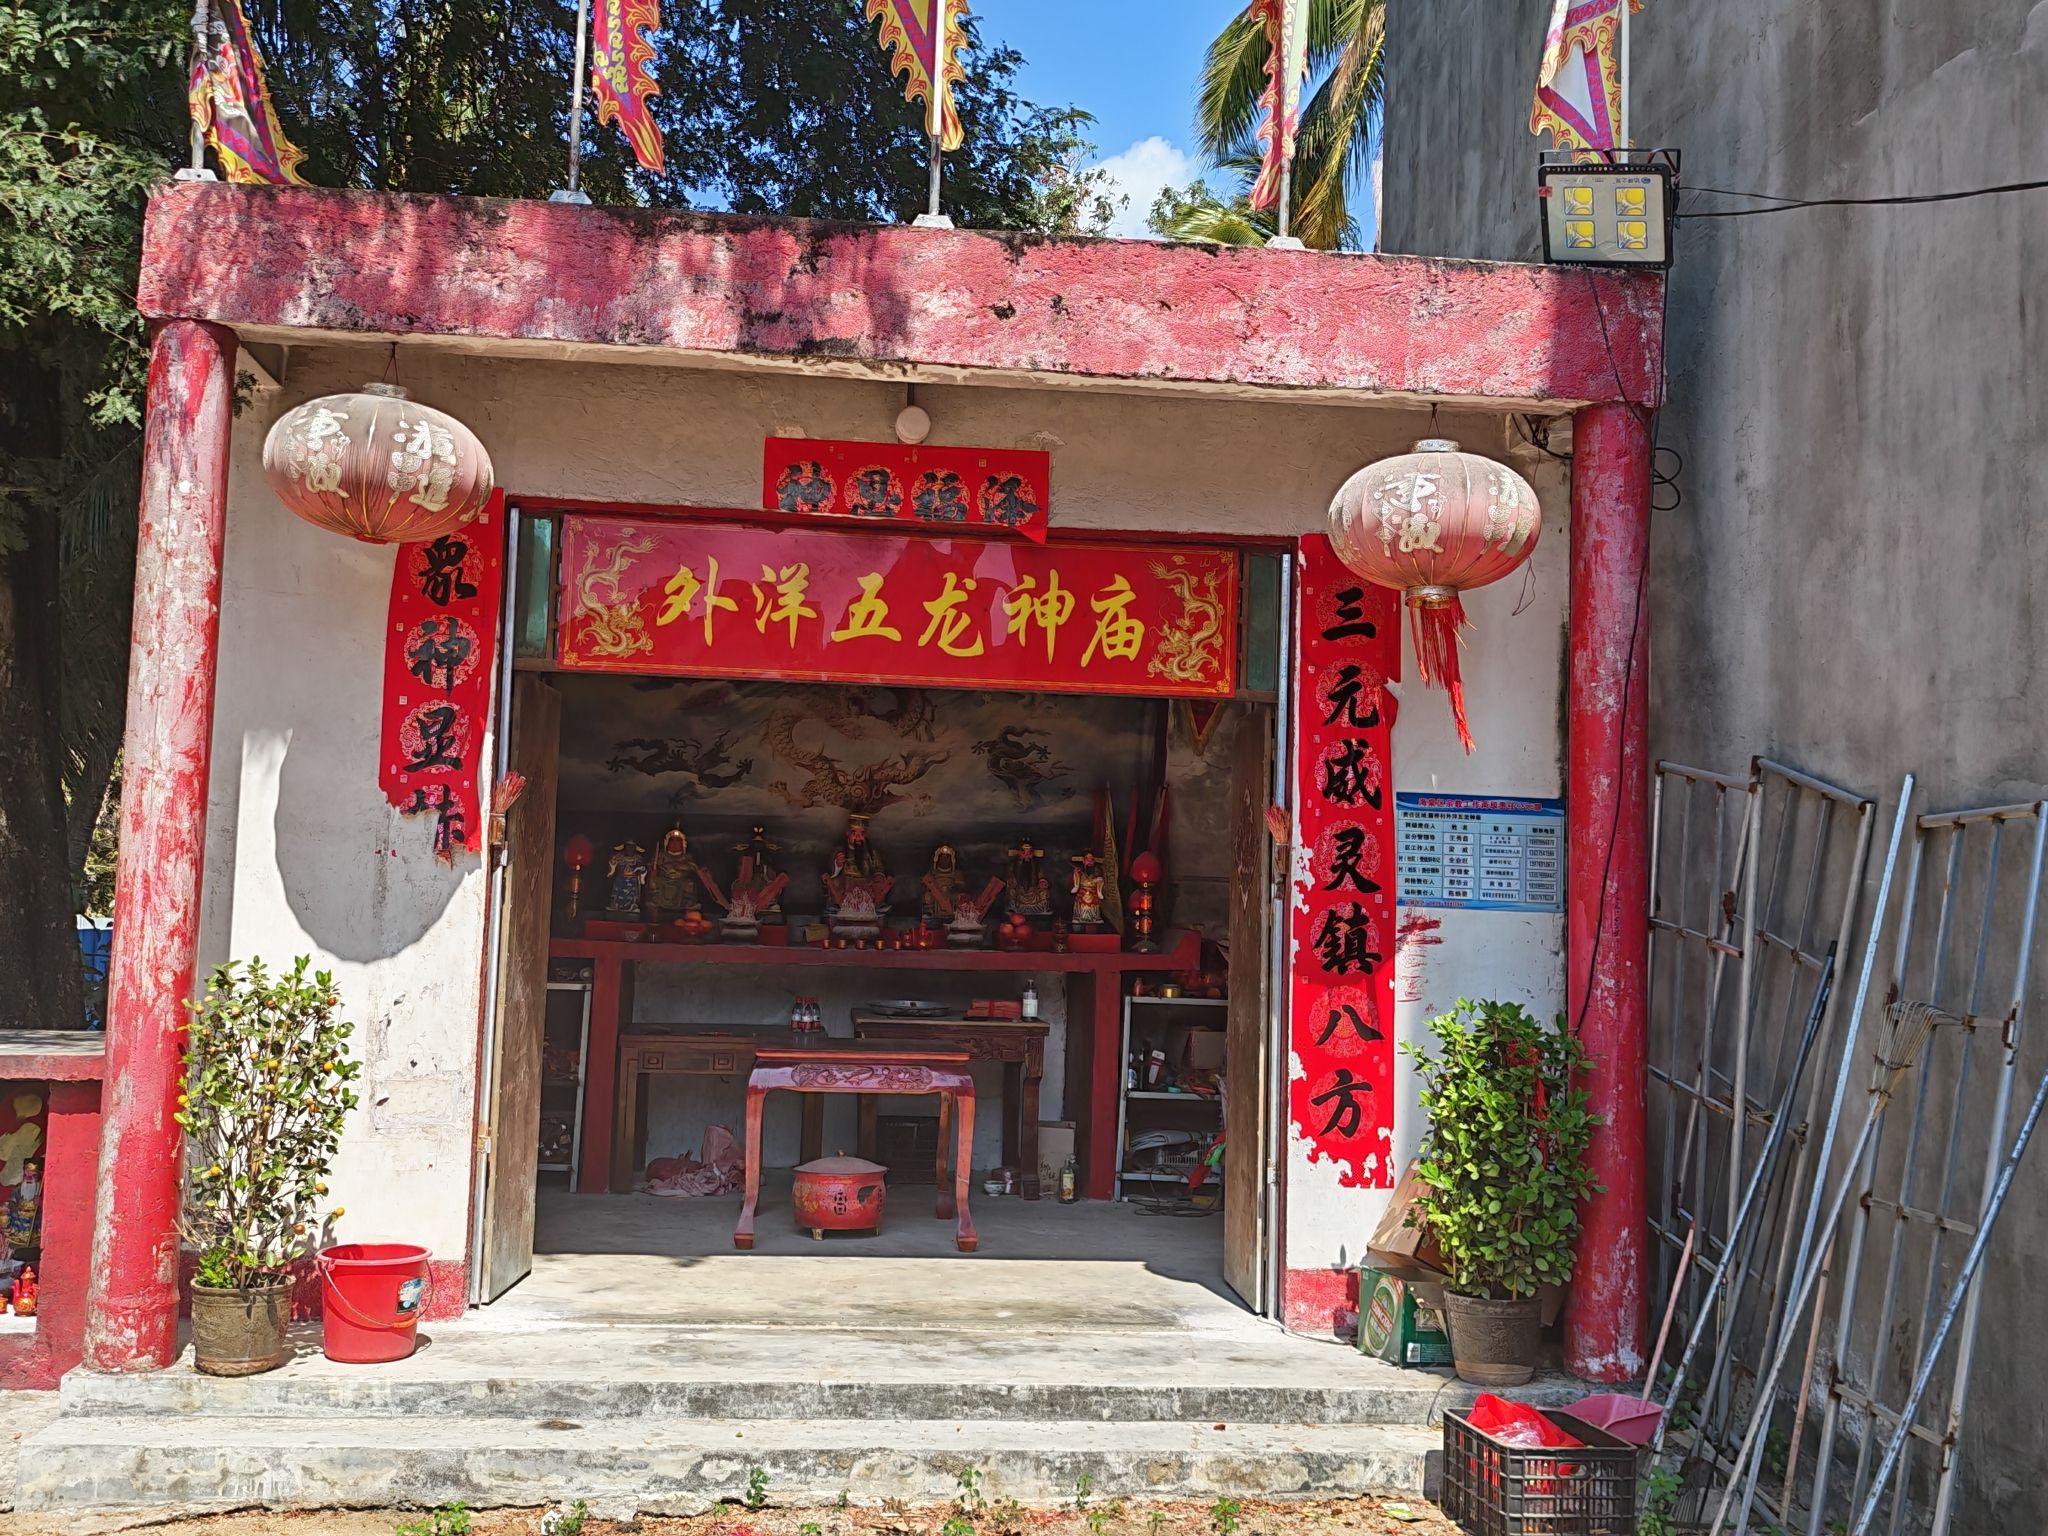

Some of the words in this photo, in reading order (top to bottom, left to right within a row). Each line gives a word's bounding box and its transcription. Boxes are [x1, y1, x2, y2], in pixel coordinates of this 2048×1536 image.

[656, 554, 1148, 668] 外洋五龙神庙
